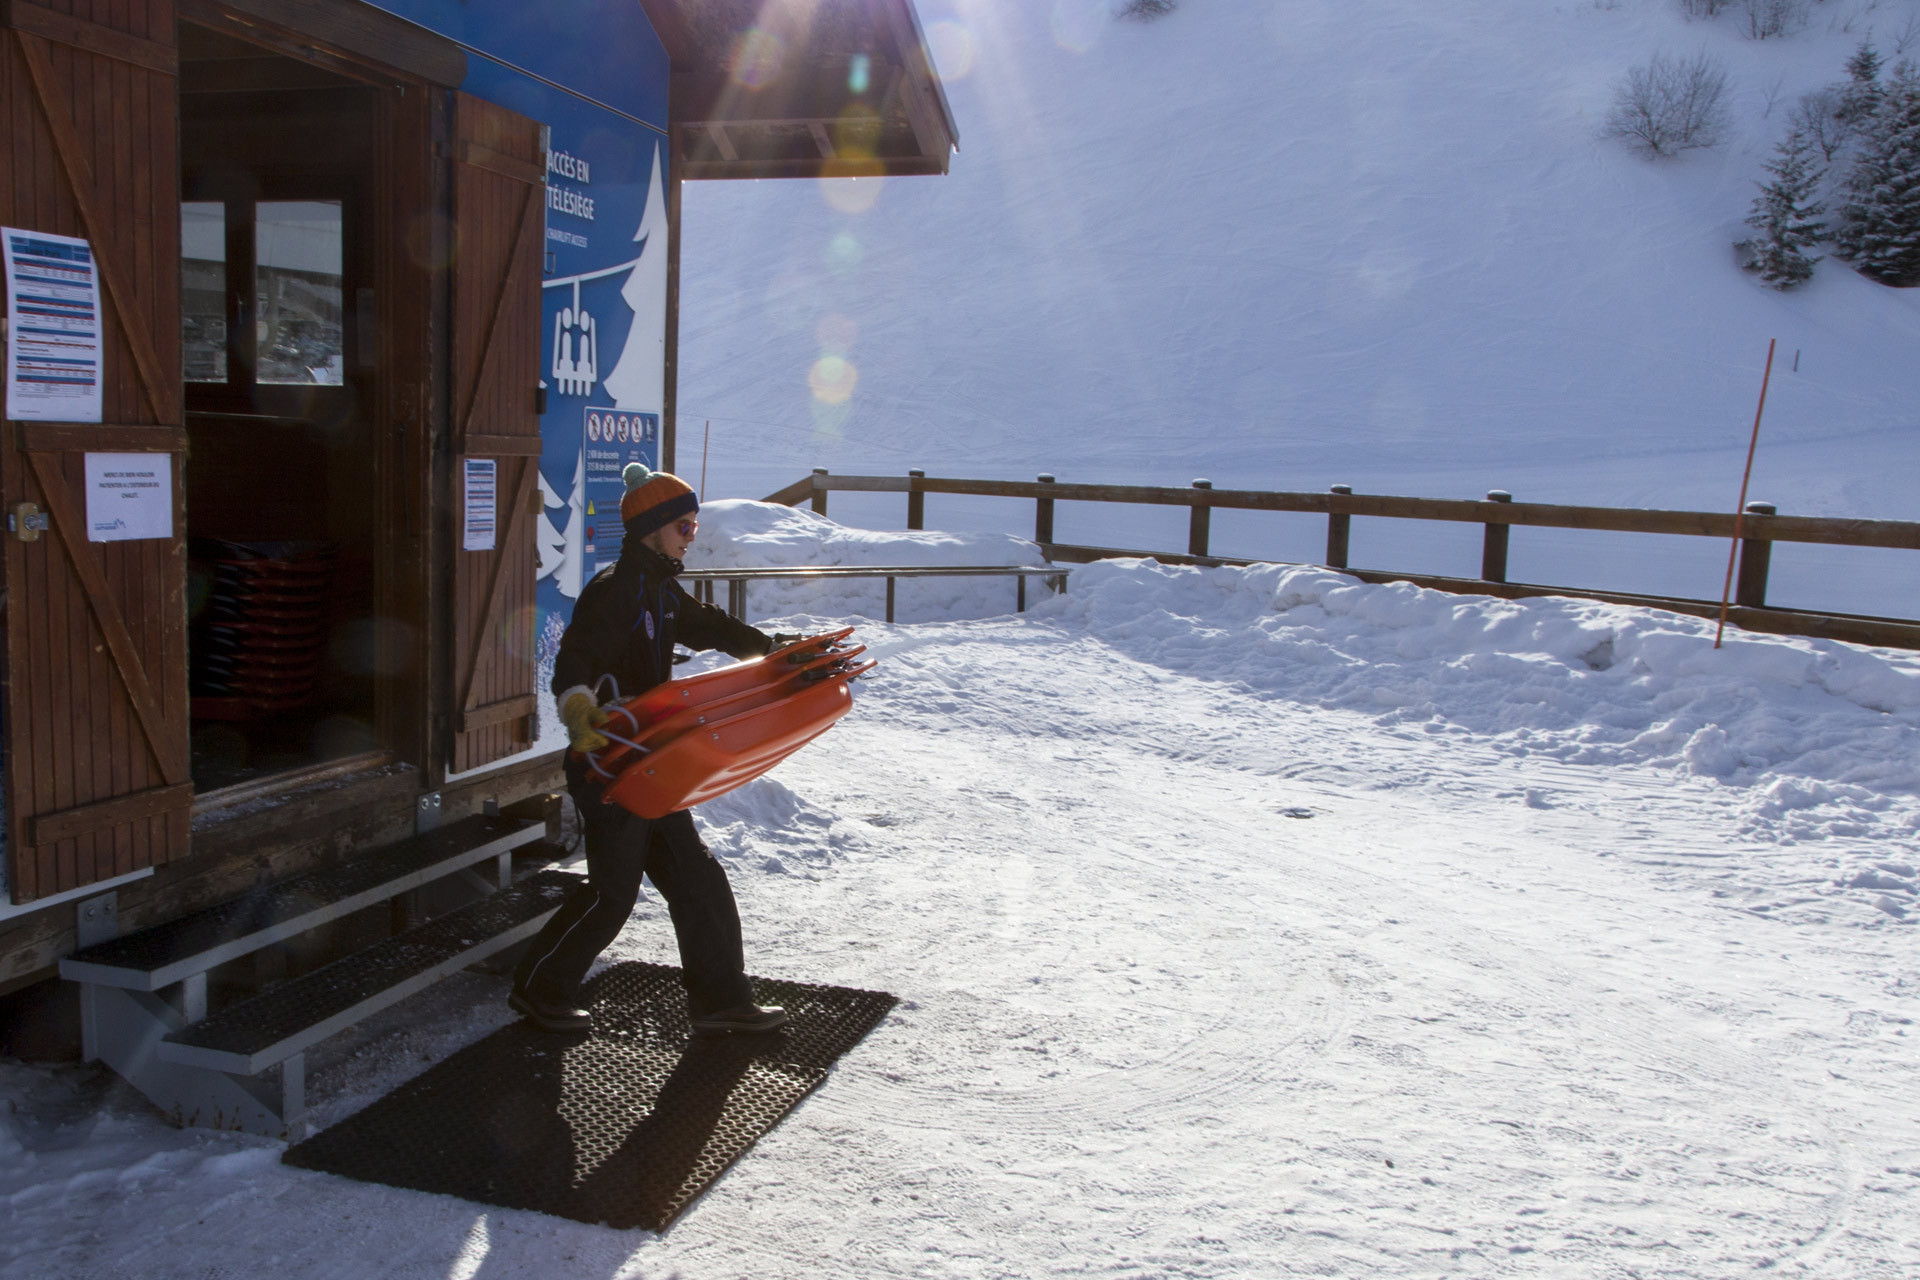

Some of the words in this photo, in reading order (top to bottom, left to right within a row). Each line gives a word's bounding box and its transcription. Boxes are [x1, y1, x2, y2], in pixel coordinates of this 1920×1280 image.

[546, 149, 575, 179] ACCÈS
[577, 159, 590, 184] EN
[547, 183, 595, 221] TÉLÉSIÈGE
[547, 227, 571, 244] CHAIRLIFT
